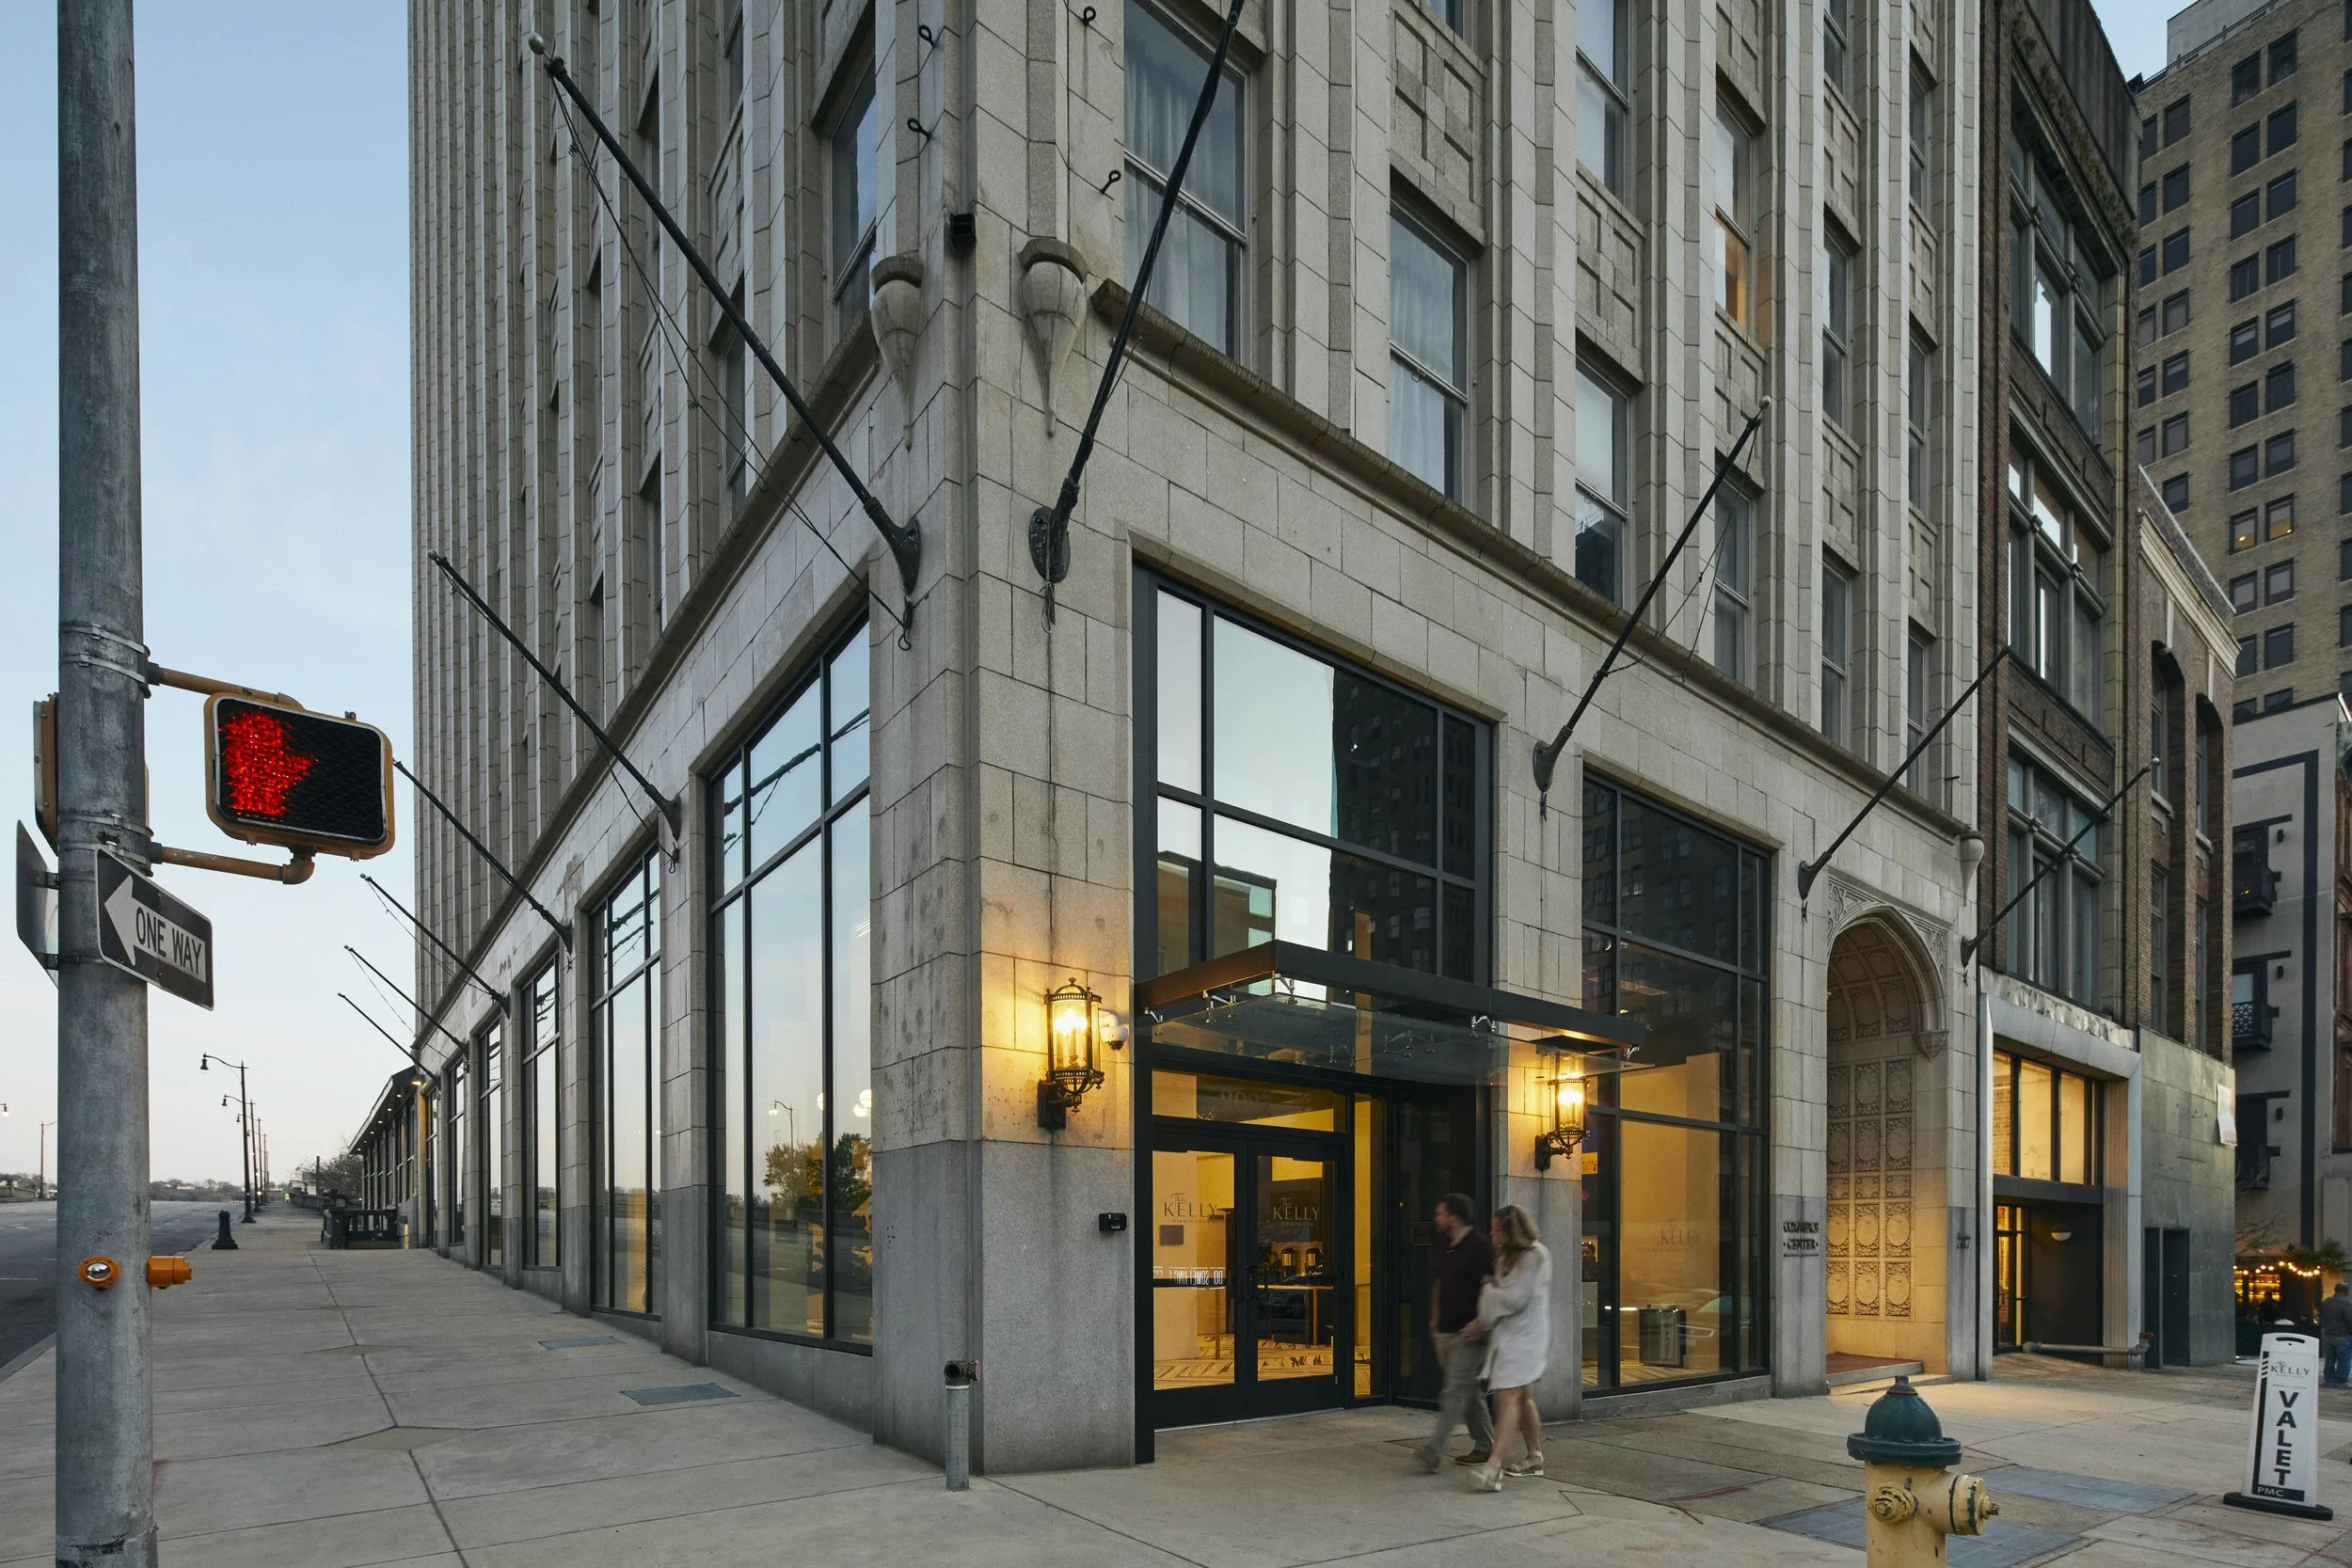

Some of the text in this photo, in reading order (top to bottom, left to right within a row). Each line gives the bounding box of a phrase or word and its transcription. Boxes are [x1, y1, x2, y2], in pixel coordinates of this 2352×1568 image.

[135, 907, 201, 974] ONE WAY
[1164, 1201, 1217, 1217] KELLY
[1273, 1206, 1320, 1221] KELLY
[1787, 1239, 1816, 1250] CENTER
[2270, 1365, 2311, 1376] KELLY
[2274, 1390, 2299, 1486] VALET
[2257, 1486, 2284, 1497] PMC
